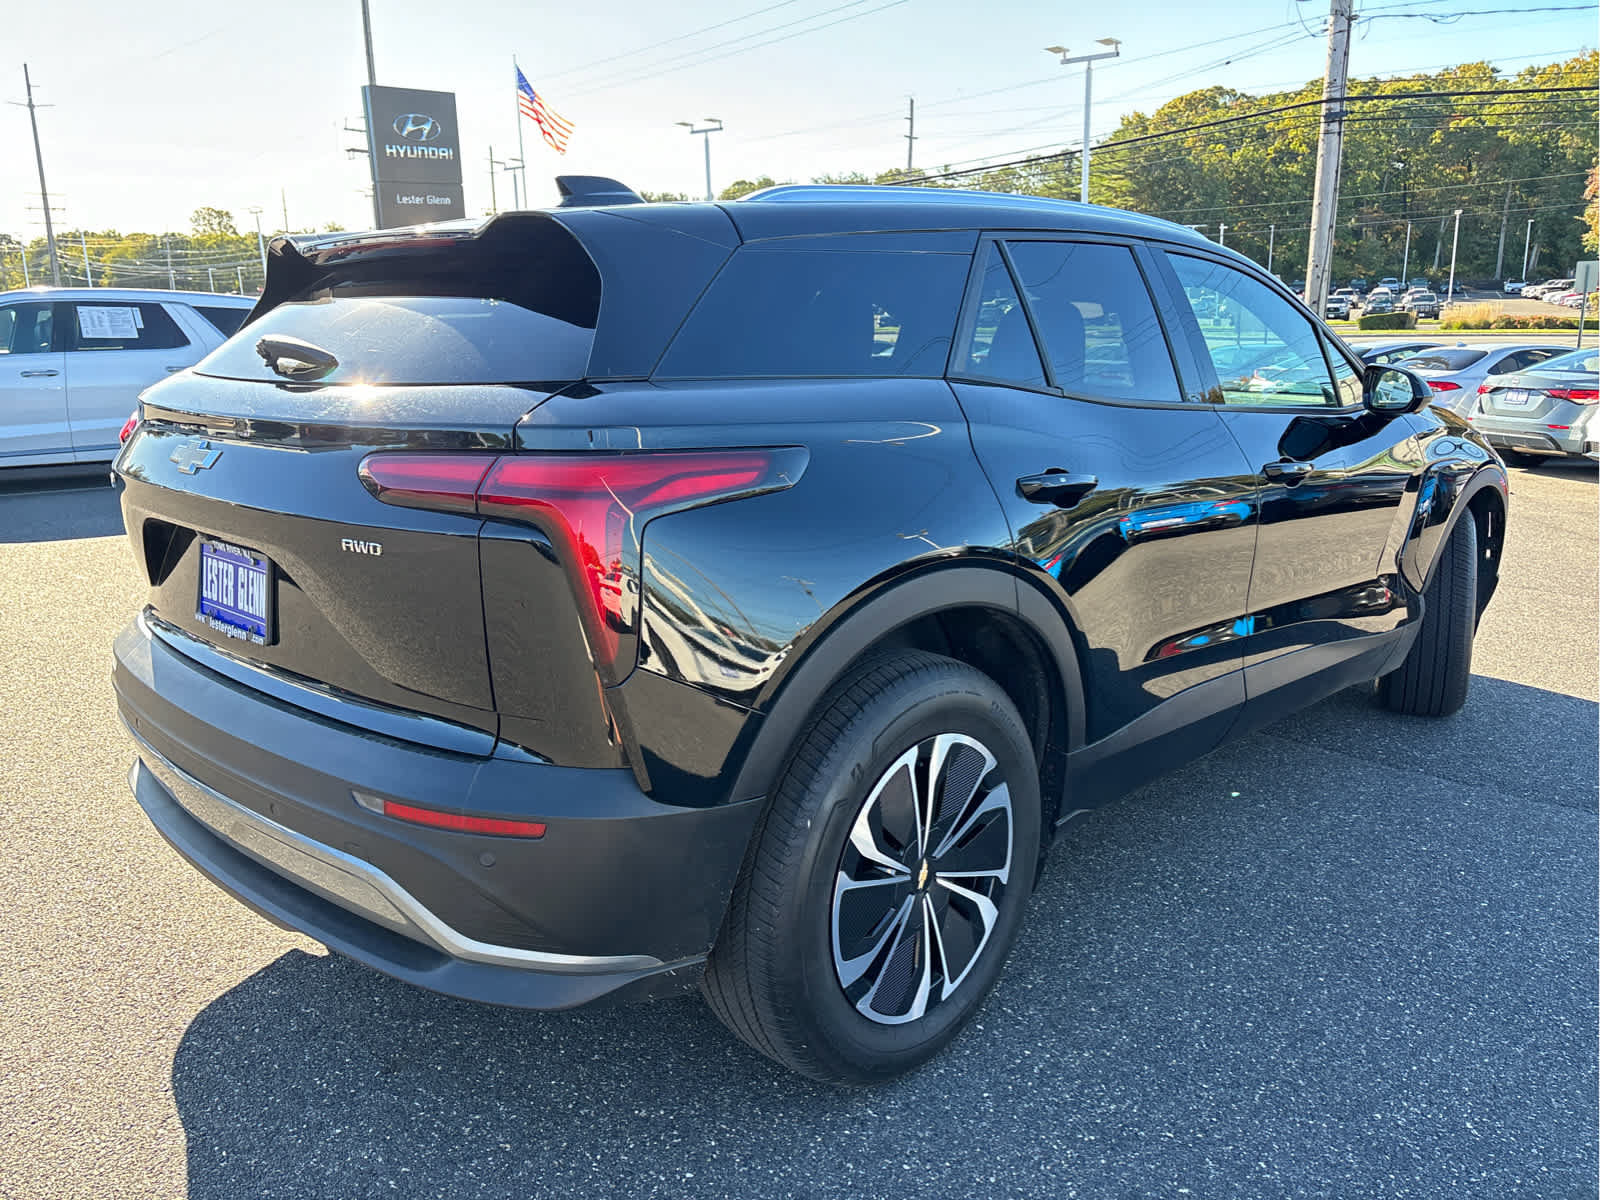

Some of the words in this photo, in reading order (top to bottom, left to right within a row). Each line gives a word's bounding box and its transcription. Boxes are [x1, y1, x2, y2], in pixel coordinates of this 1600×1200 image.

[385, 144, 453, 160] HYUNDAI
[396, 193, 424, 205] Lester
[426, 195, 451, 205] Glenn
[341, 538, 382, 556] AWD
[202, 556, 235, 608] LESTER
[237, 566, 266, 619] GLENN
